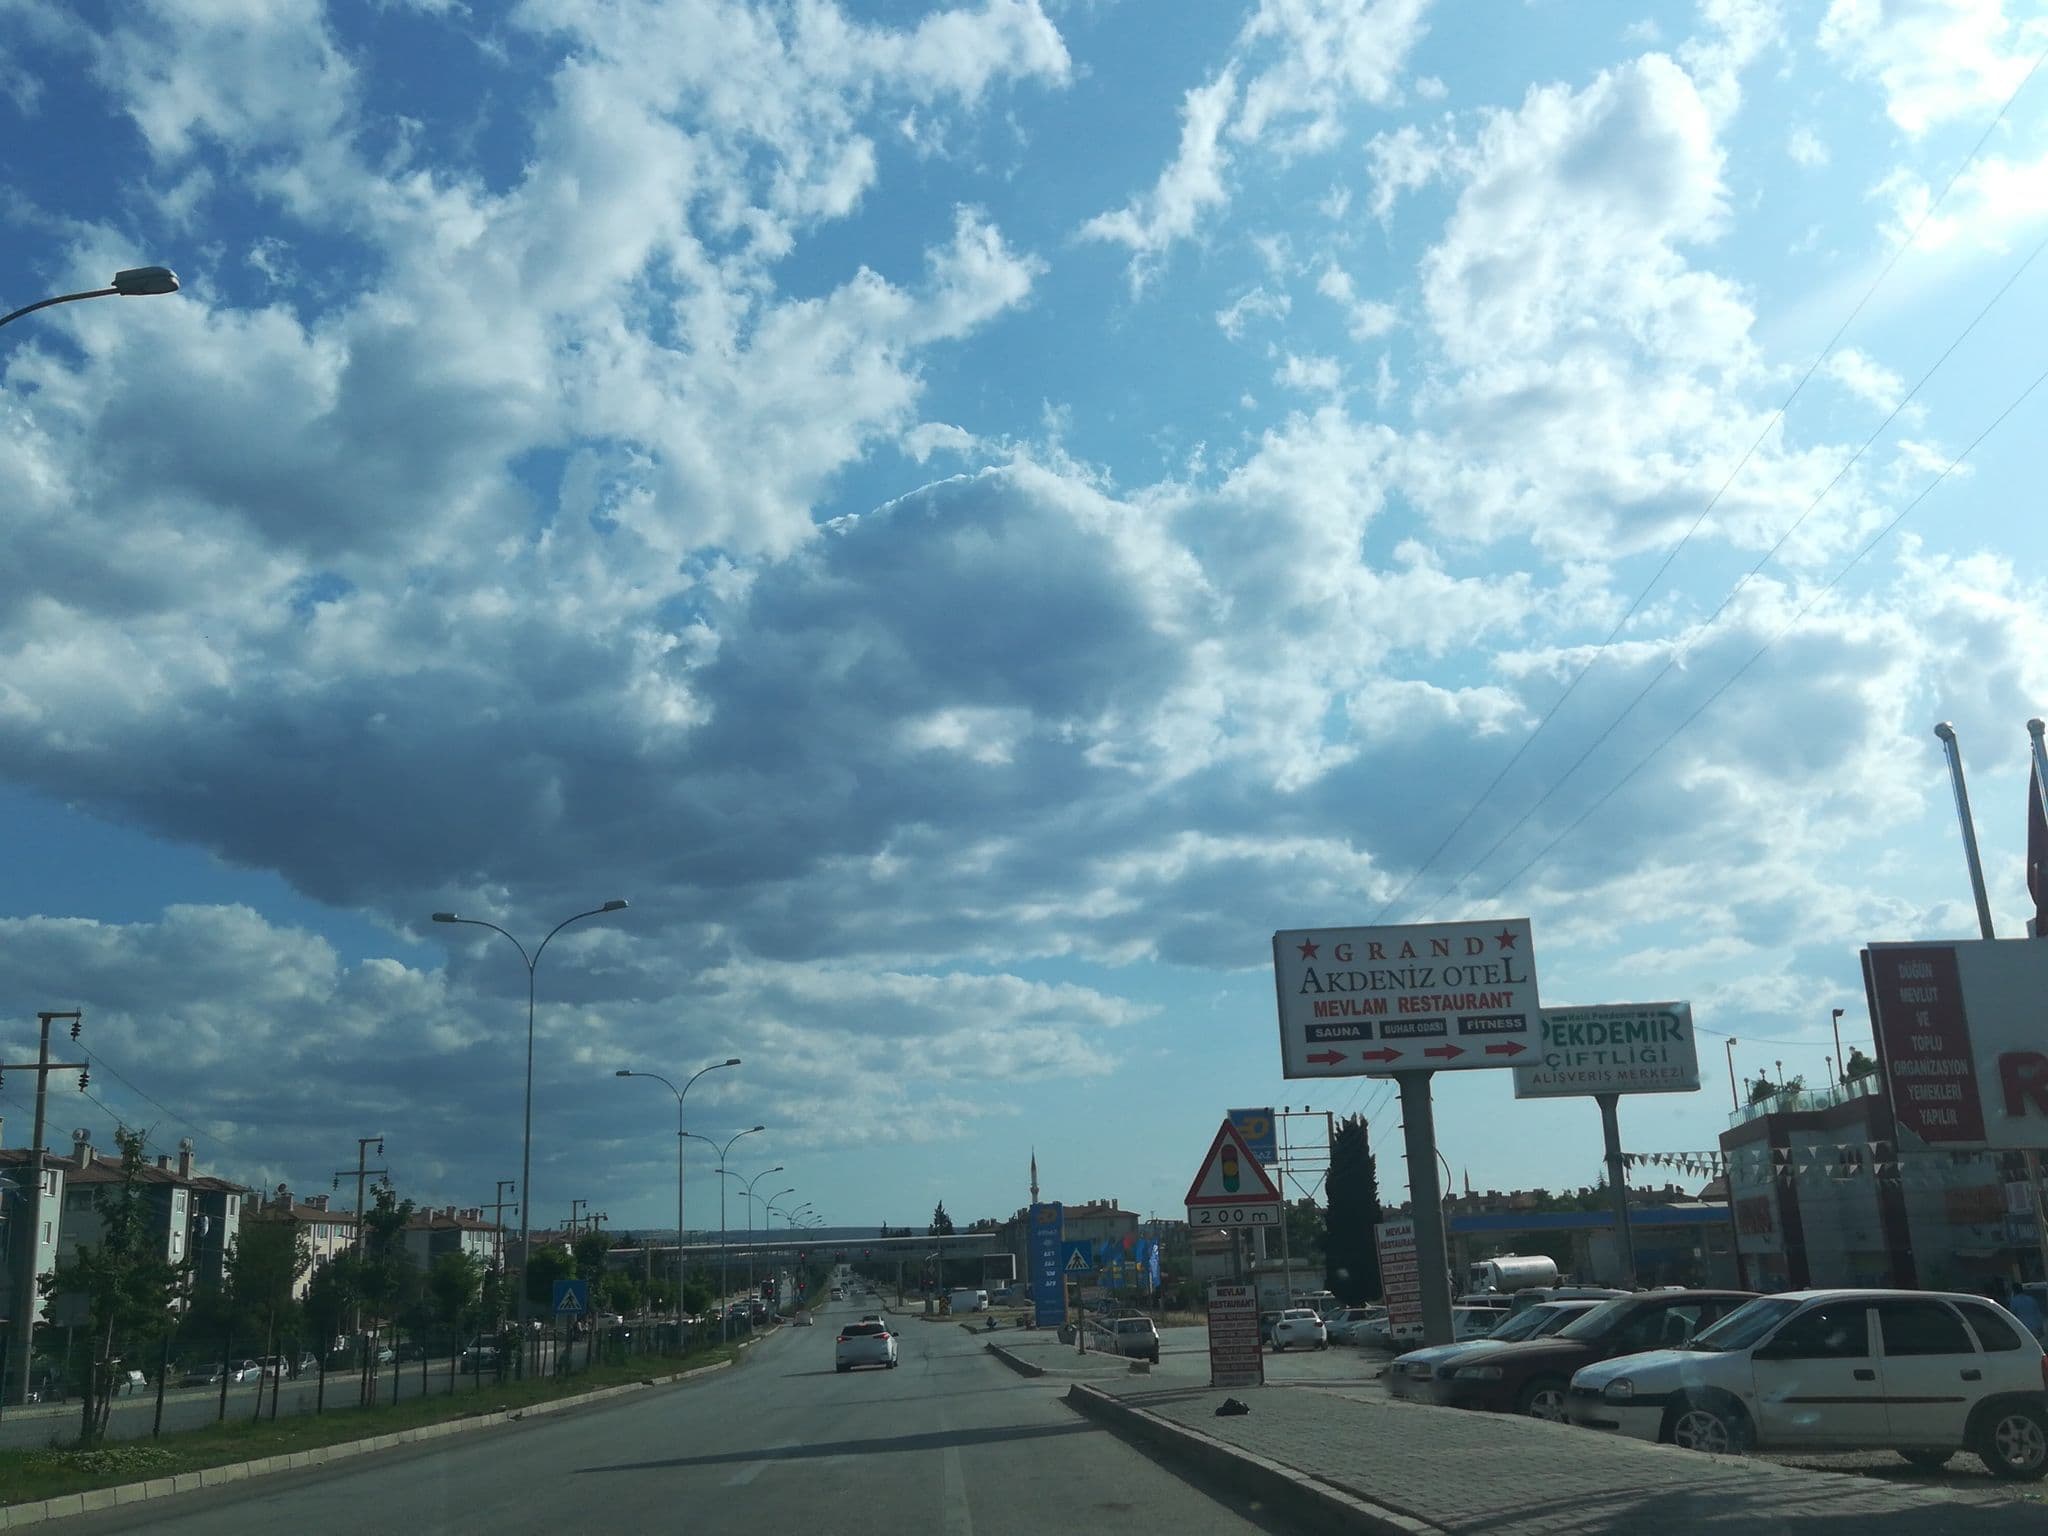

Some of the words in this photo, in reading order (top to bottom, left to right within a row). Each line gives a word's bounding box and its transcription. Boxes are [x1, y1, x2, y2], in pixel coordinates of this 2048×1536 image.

[1335, 936, 1484, 962] GRAND
[1299, 963, 1434, 994] AKDENİZ
[1443, 957, 1527, 986] OTEL
[1313, 997, 1387, 1018] MEVLAM
[1398, 991, 1514, 1013] RESTAURANT
[1315, 1026, 1360, 1038] SAUNA
[1384, 1024, 1415, 1034] BUHAR
[1417, 1022, 1444, 1033] ODASI
[1911, 1034, 1943, 1052] TOPLU
[1545, 1046, 1668, 1071] ÇİFTLİĞİ
[1200, 1208, 1244, 1224] 200
[1252, 1212, 1268, 1222] m
[1216, 1287, 1246, 1297] MEVLAM
[1210, 1299, 1255, 1309] RESTAURANT
